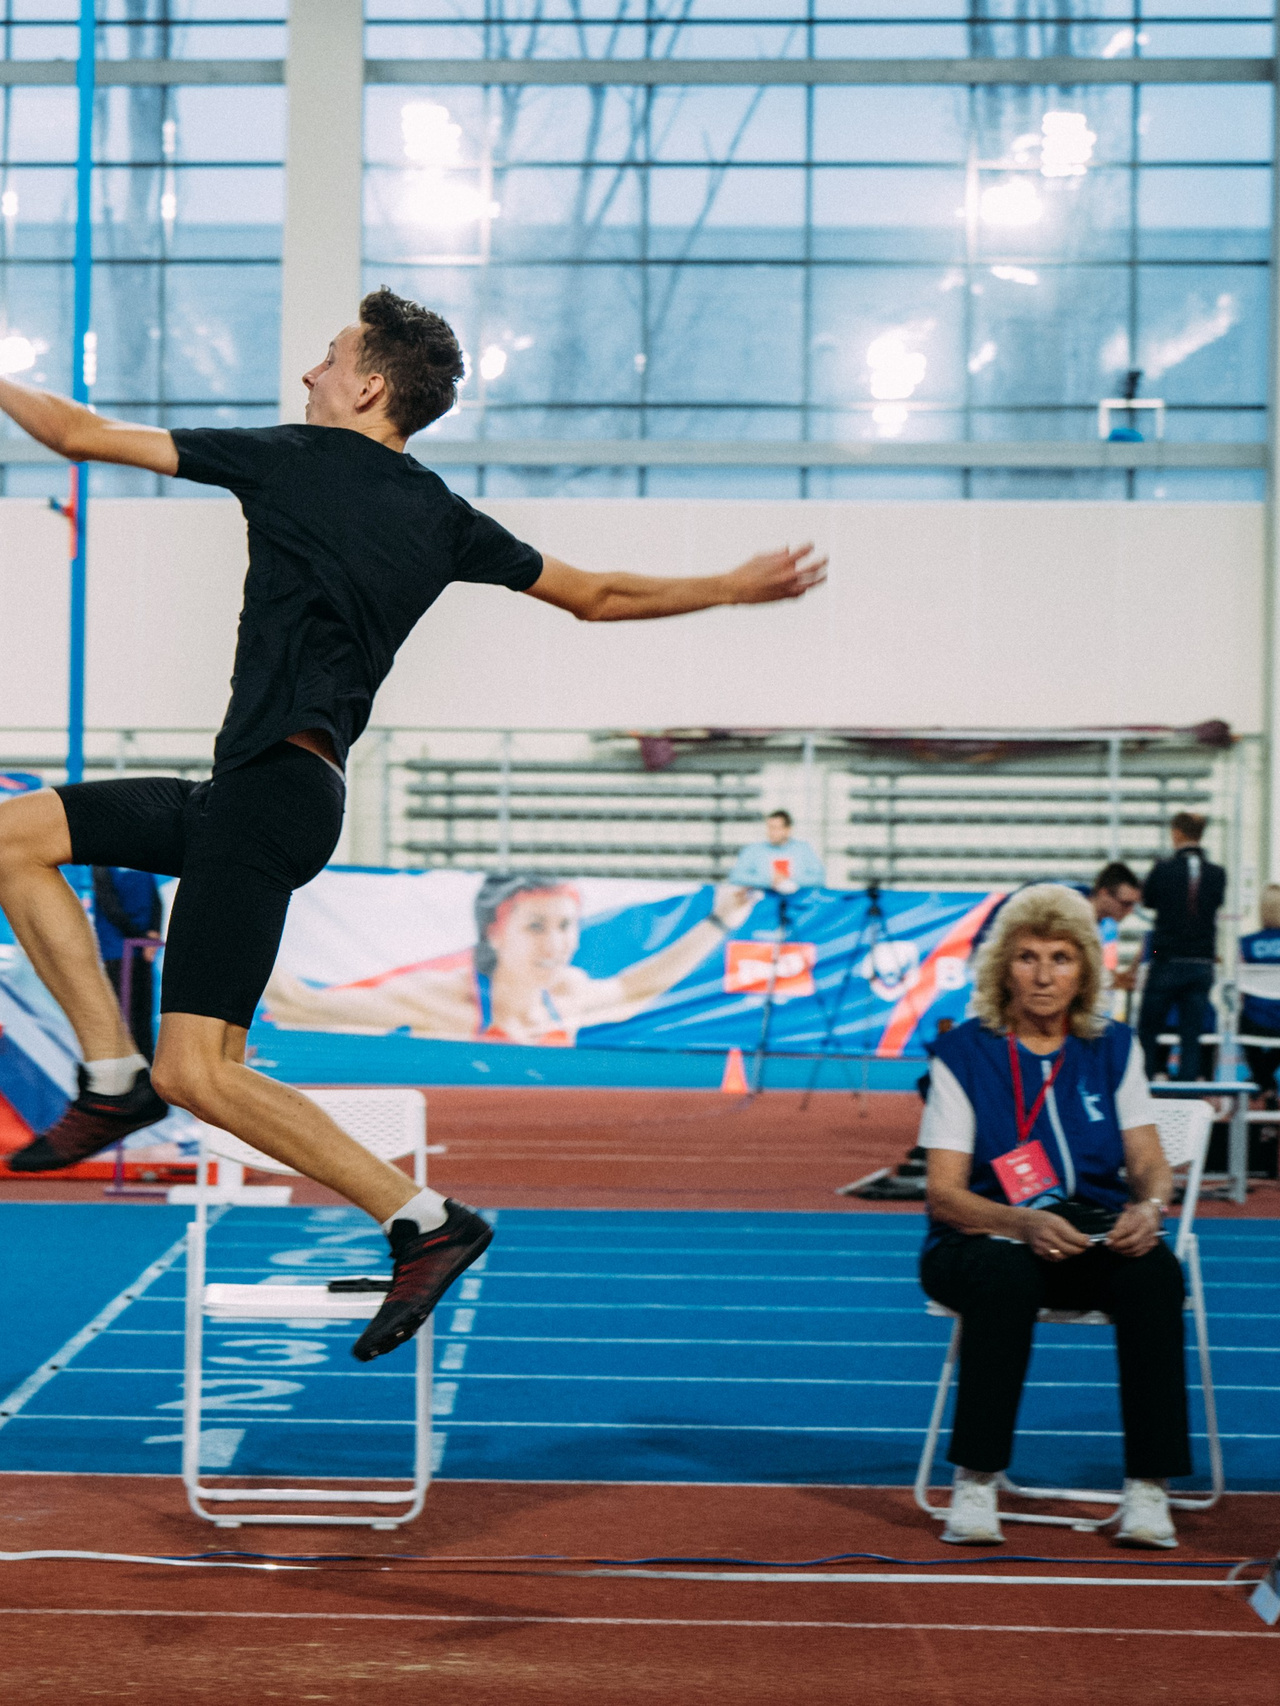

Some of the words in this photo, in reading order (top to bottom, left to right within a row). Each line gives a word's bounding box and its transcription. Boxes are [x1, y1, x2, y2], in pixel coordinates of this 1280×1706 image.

[268, 1247, 383, 1268] 6
[206, 1338, 330, 1367] 3
[155, 1378, 306, 1412] 2
[142, 1428, 247, 1468] 1
